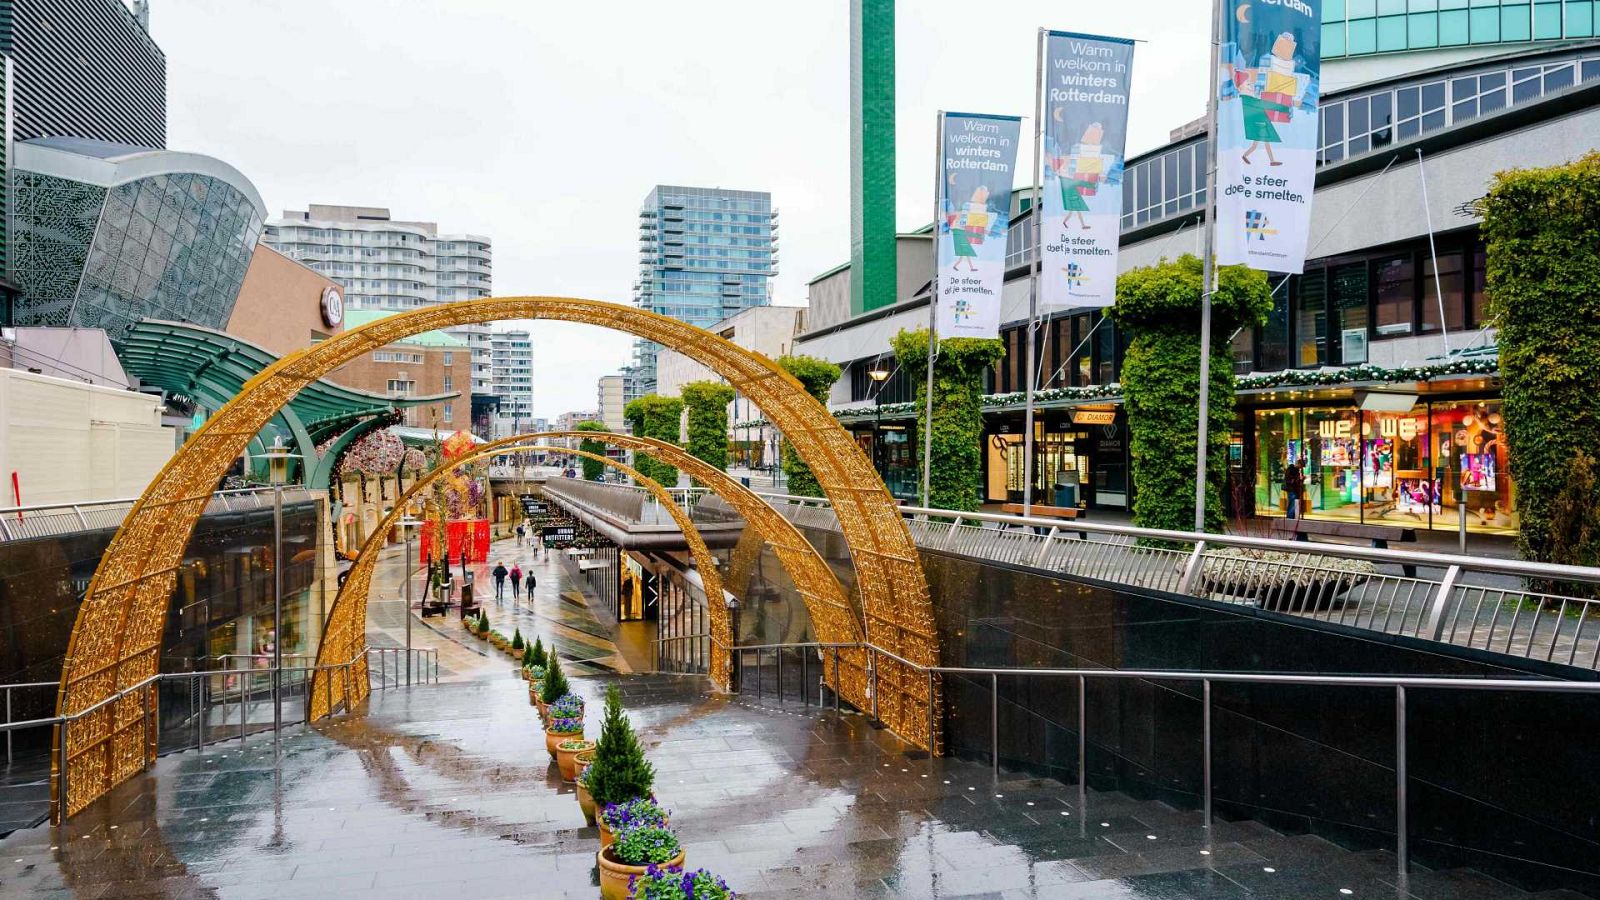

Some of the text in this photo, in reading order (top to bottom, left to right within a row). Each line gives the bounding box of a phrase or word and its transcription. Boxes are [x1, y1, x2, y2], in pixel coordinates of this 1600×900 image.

[1070, 41, 1113, 57] Warm
[1054, 57, 1126, 73] welkom in
[1061, 72, 1117, 88] winters
[1050, 88, 1126, 104] Rotterdam
[963, 119, 999, 133] Warm
[949, 133, 1010, 147] welkom in
[955, 145, 1001, 158] winters
[946, 158, 1008, 172] Rotterdam
[1242, 174, 1288, 187] e sfeer
[1225, 184, 1245, 196] doe
[1255, 189, 1305, 204] smelten.
[1061, 234, 1096, 246] De sfeer
[1072, 246, 1113, 256] smelten.
[962, 276, 982, 285] sfeer
[1087, 413, 1113, 421] DIAMOR
[1319, 418, 1416, 438] WE WE
